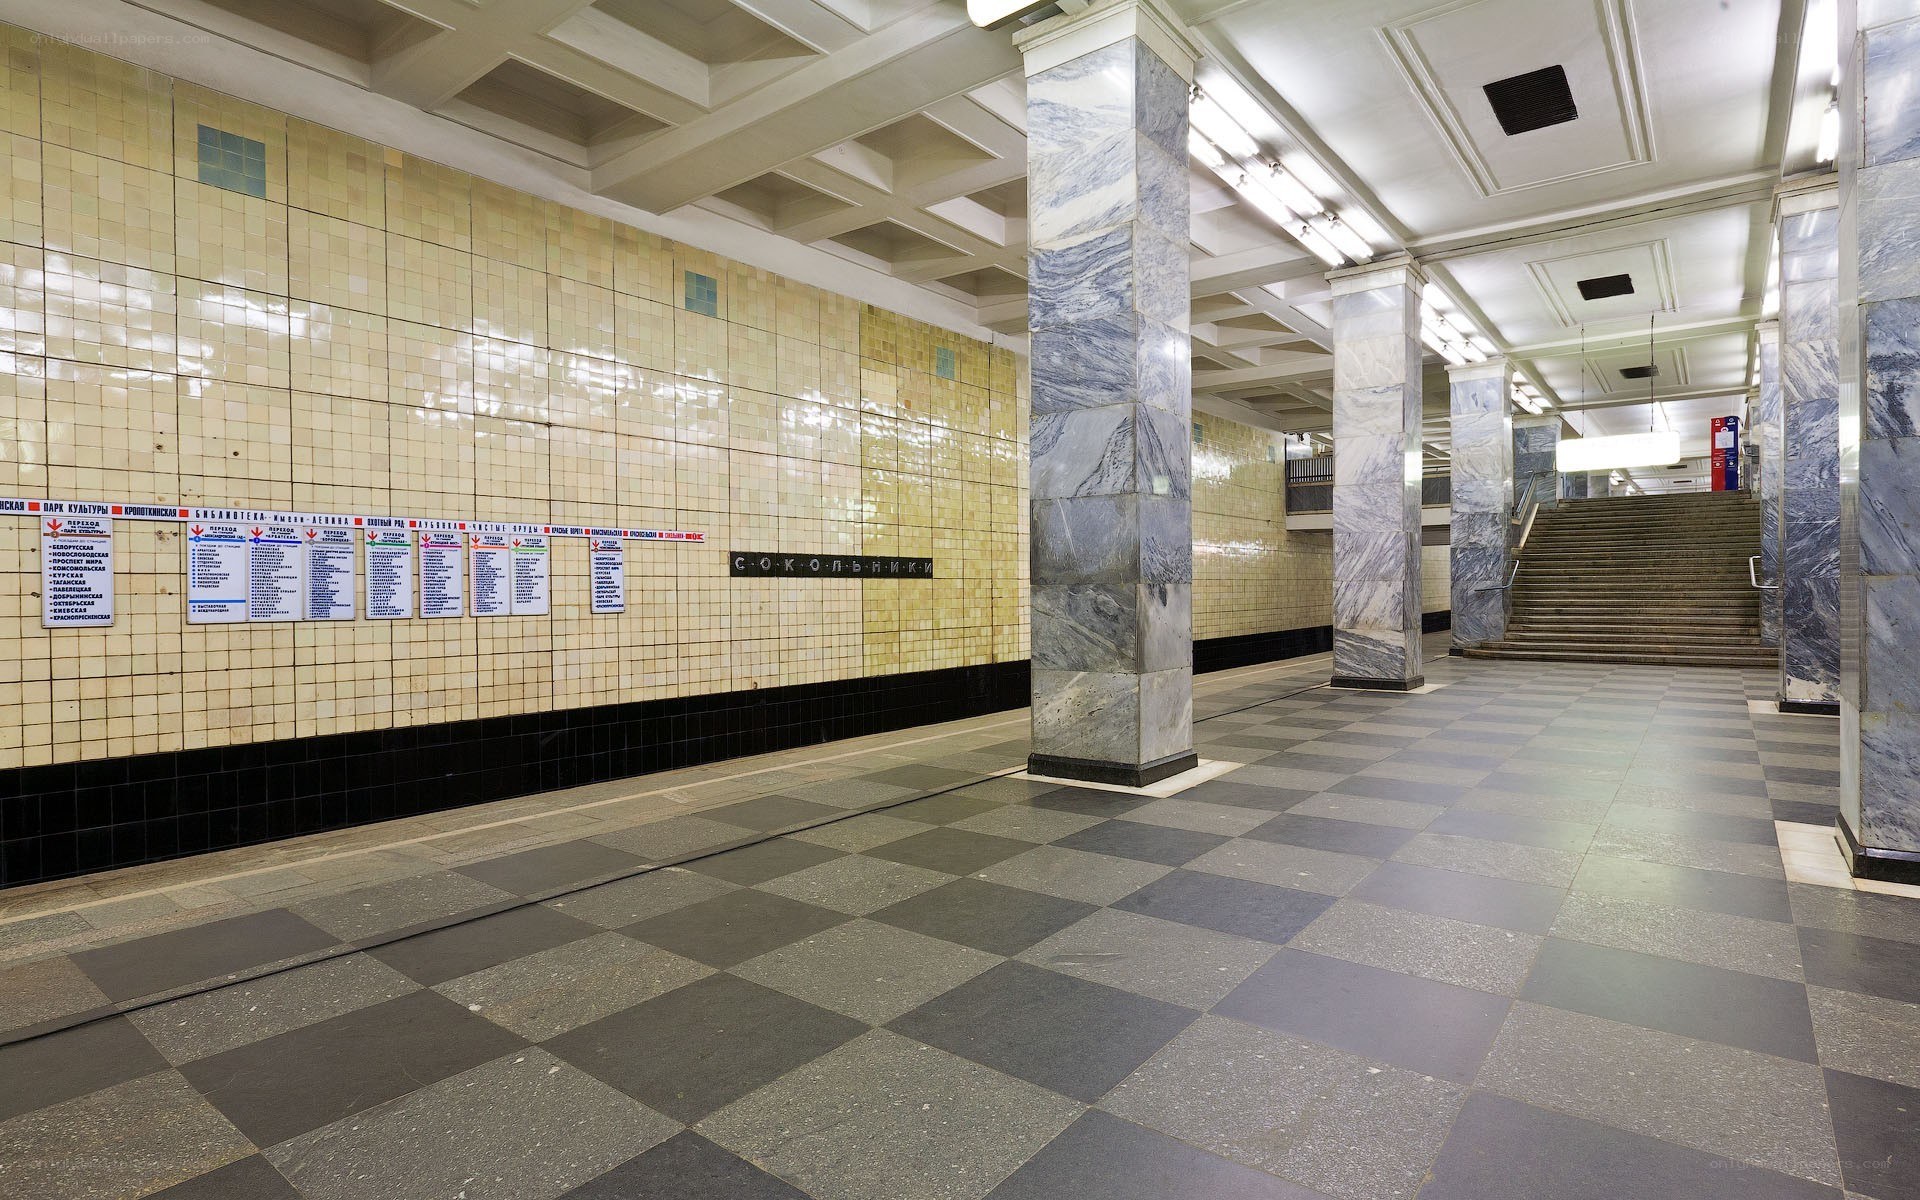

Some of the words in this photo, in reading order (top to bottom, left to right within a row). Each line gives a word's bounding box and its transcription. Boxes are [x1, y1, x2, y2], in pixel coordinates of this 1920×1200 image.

[43, 502, 64, 513] ПАРК
[68, 503, 108, 515] КУЛЬТУРЫ
[124, 506, 177, 518] КРОПОТКИНСКАЯ
[312, 515, 349, 526] ЛЕНИНА
[367, 517, 392, 527] ОХОТНЫЙ
[394, 519, 405, 529] РЯД
[418, 520, 458, 530] ЛУБЯНКА
[734, 557, 932, 573] СОКОЛЬНИКИ
